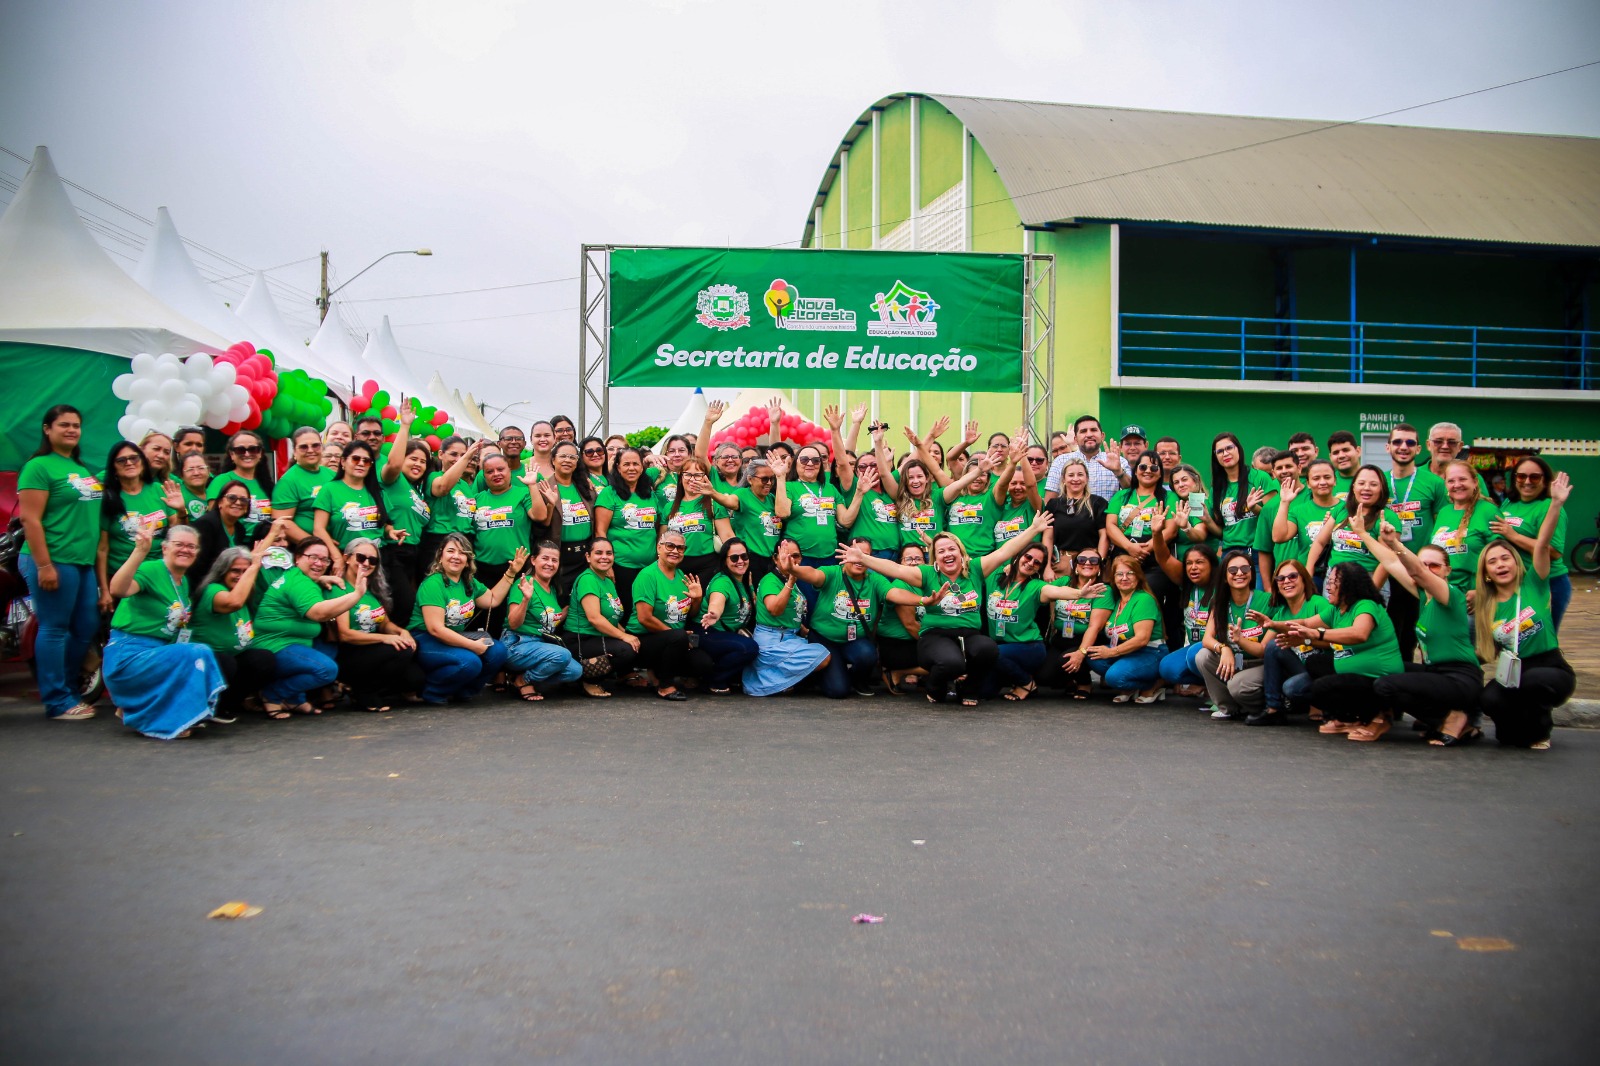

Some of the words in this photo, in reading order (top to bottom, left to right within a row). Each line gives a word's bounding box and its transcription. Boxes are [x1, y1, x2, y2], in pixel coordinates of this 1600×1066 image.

[797, 299, 834, 310] Nova
[654, 343, 801, 368] Secretaria
[805, 344, 840, 369] de
[844, 345, 978, 377] Educação
[1360, 413, 1405, 422] BANHEIRO
